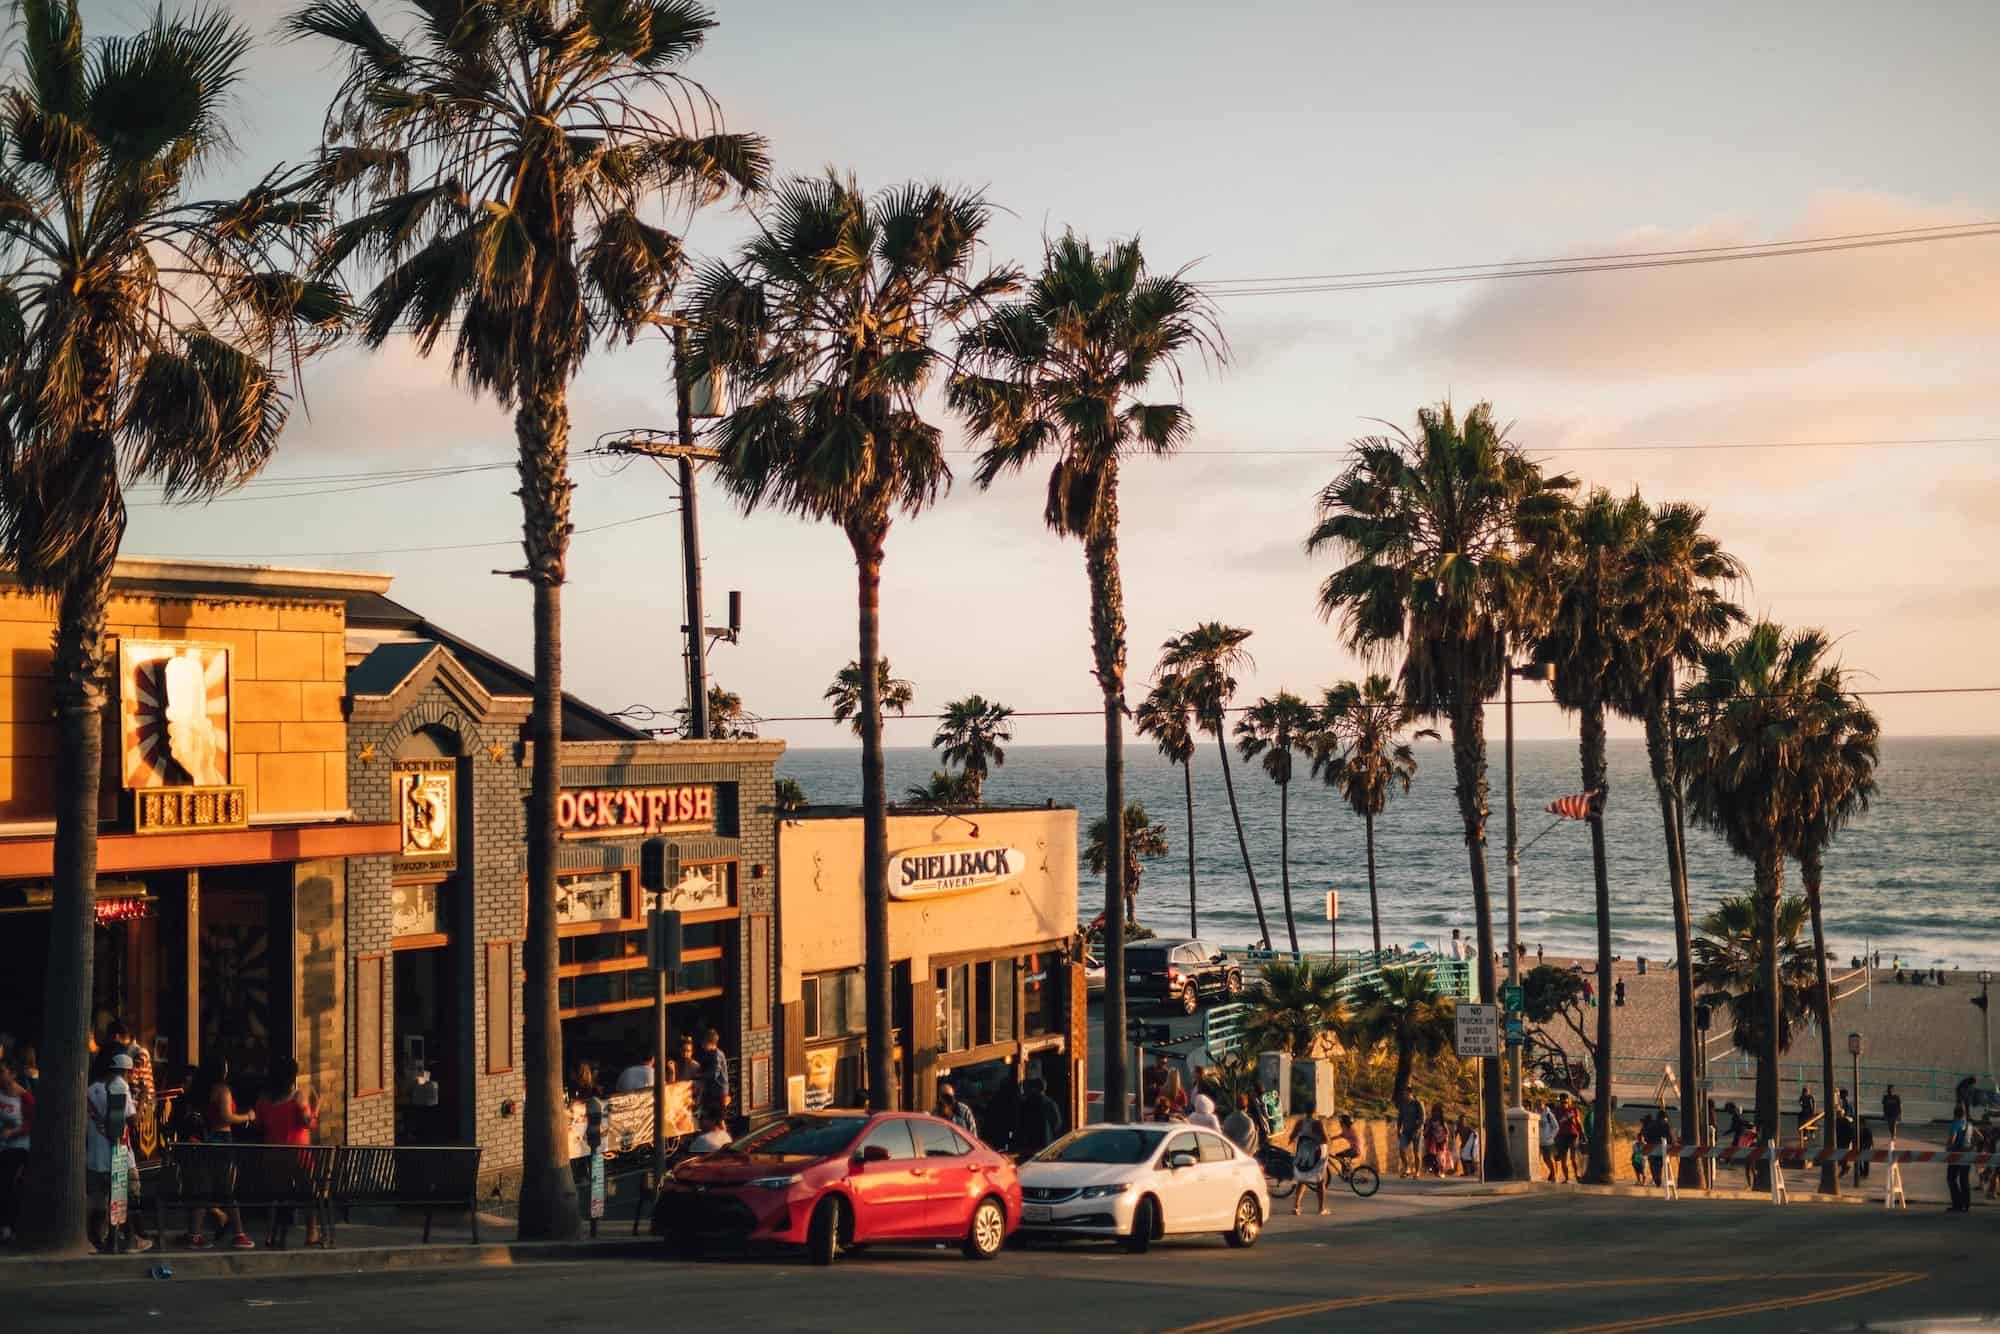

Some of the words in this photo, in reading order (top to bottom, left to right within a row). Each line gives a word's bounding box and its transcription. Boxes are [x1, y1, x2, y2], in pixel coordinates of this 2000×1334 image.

[558, 789, 645, 827] OCK'N
[646, 785, 714, 834] FISH
[901, 848, 1011, 886] SHELLBACK
[936, 877, 975, 890] TAVERN
[1470, 1007, 1482, 1016] NO
